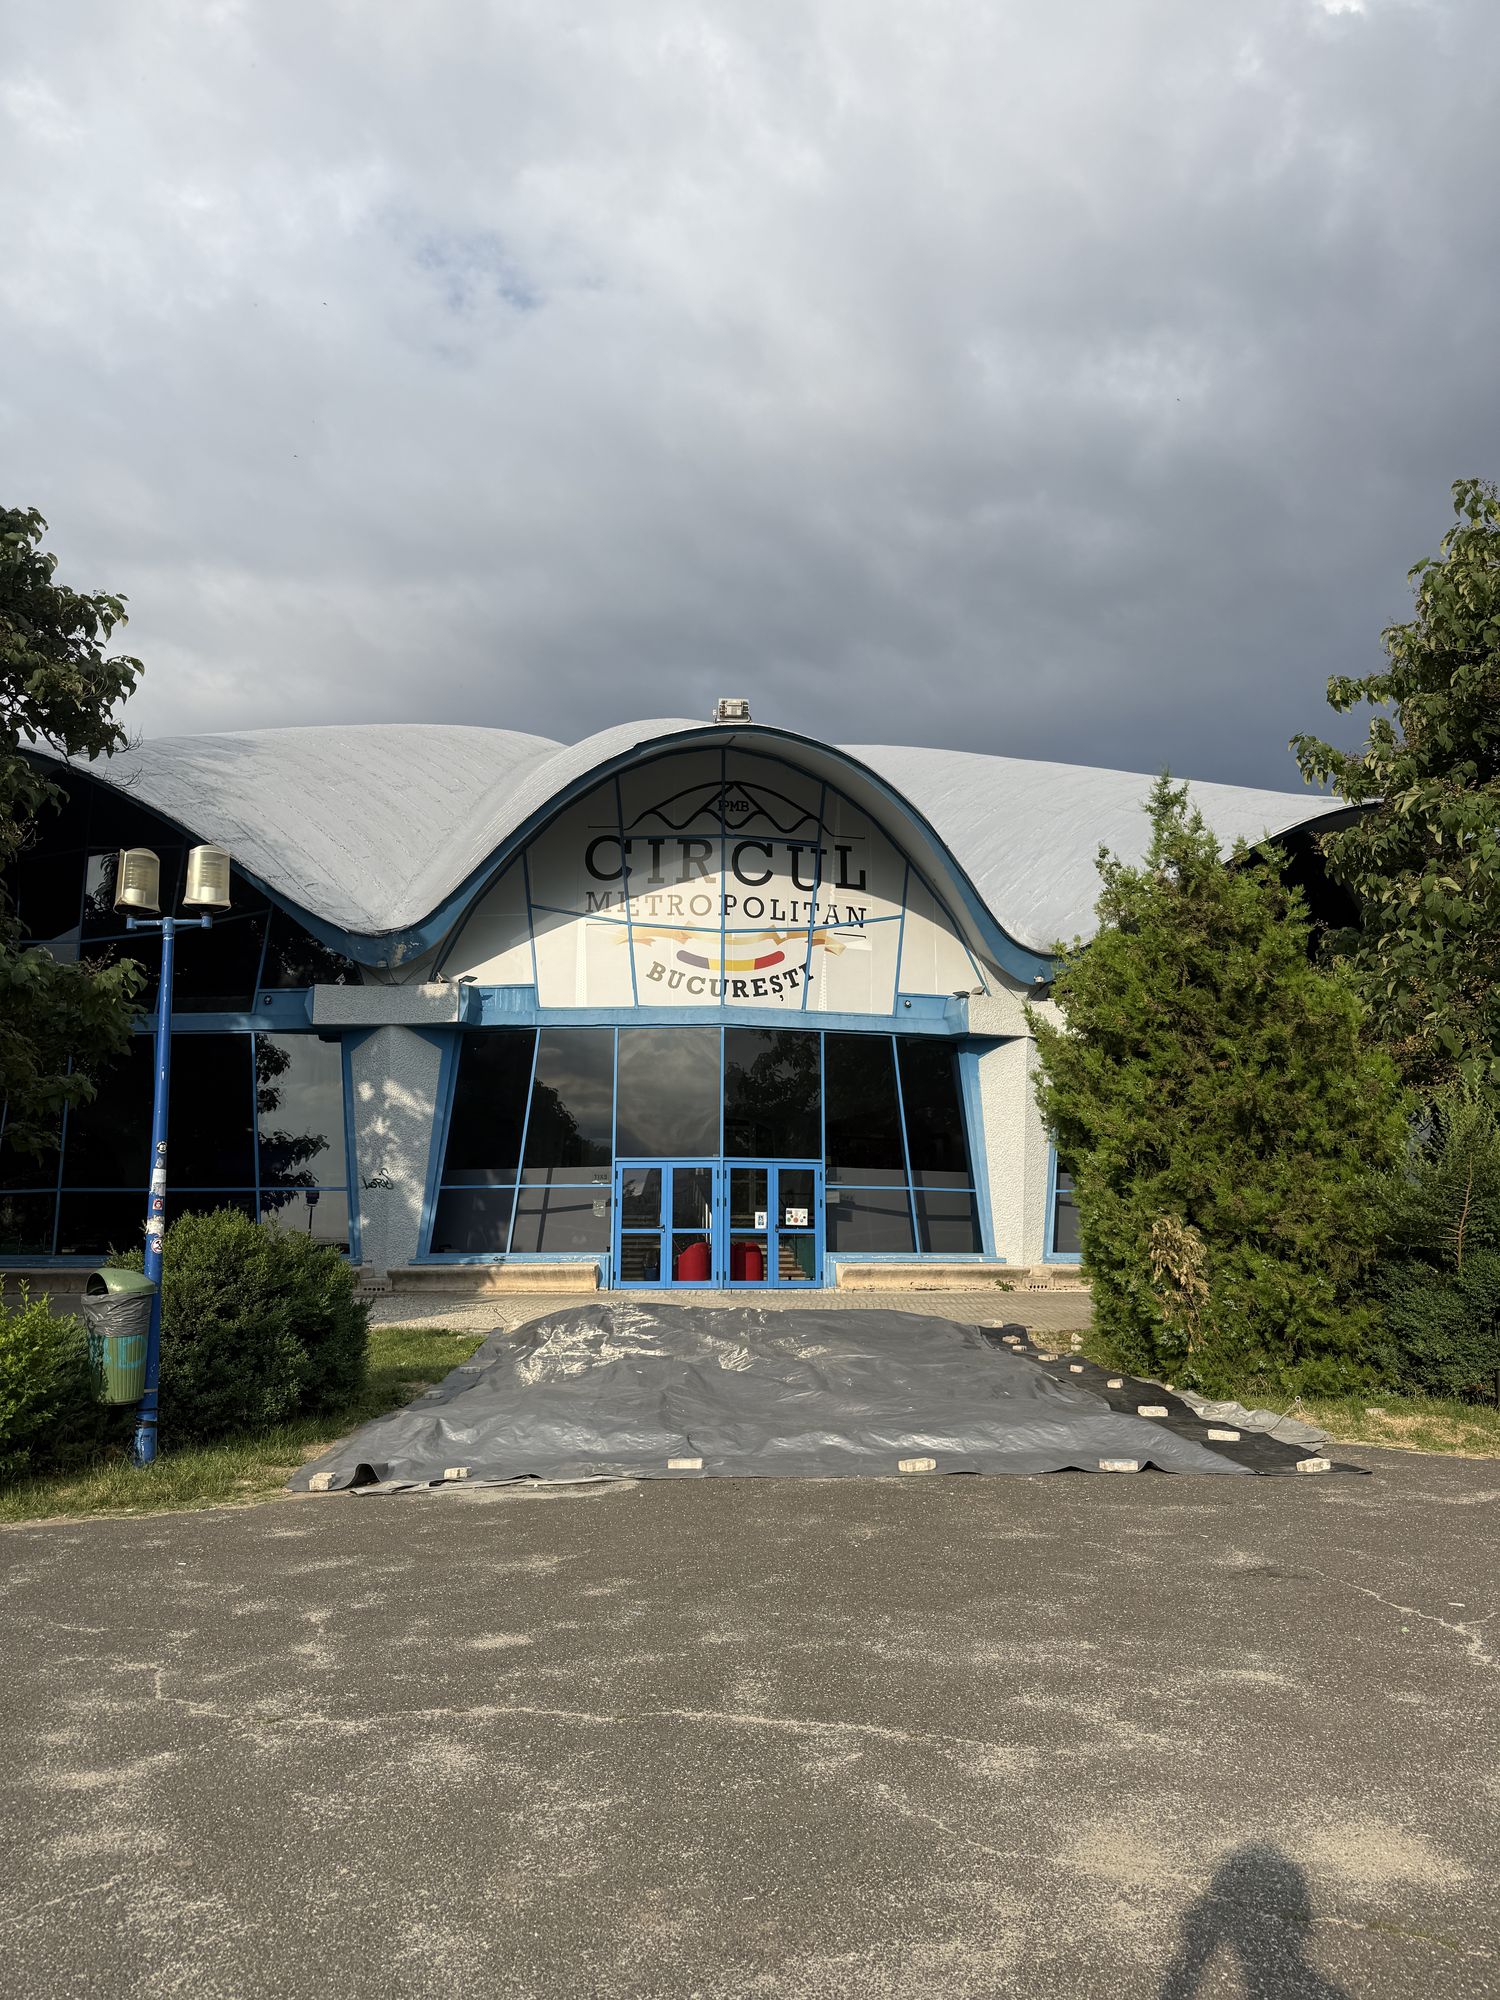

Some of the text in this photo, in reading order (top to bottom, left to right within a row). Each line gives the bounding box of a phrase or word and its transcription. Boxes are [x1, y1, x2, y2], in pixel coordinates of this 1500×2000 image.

[718, 800, 749, 812] PMB
[585, 835, 866, 891] CIRCUL
[585, 891, 867, 928] METROPOLITAN
